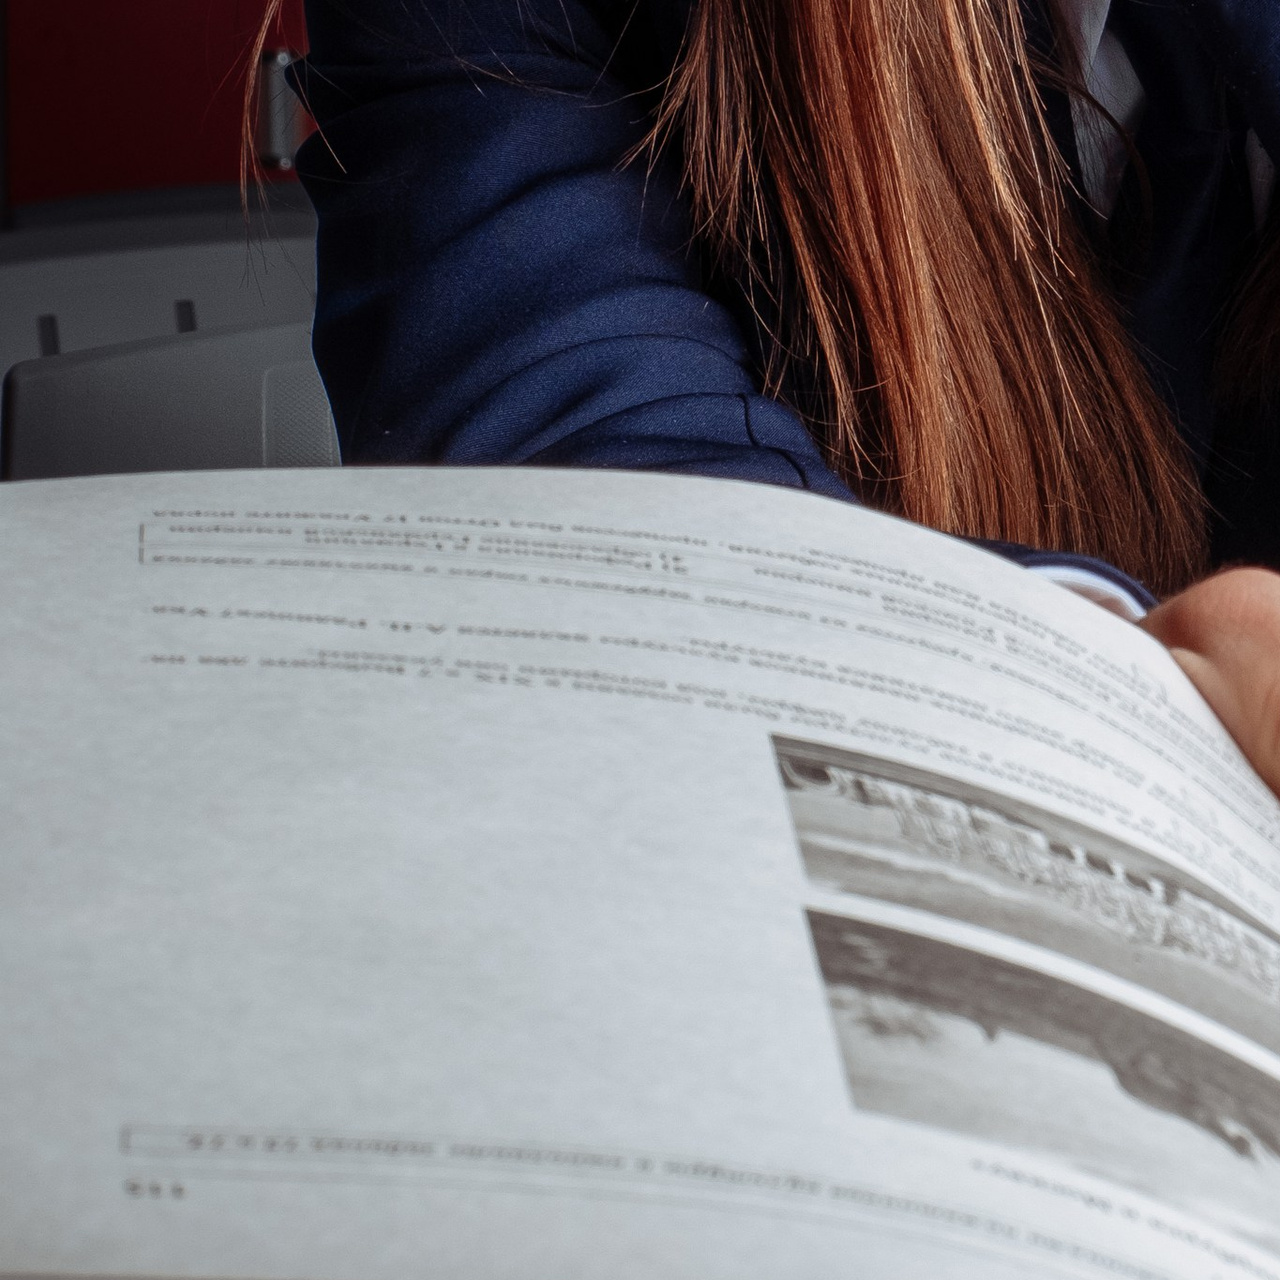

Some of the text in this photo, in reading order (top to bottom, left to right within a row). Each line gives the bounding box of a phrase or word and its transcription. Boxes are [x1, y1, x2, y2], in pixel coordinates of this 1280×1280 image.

[245, 510, 370, 522] Укажите
[169, 524, 293, 536] империи
[197, 655, 247, 666] два
[258, 657, 406, 675] Выберите
